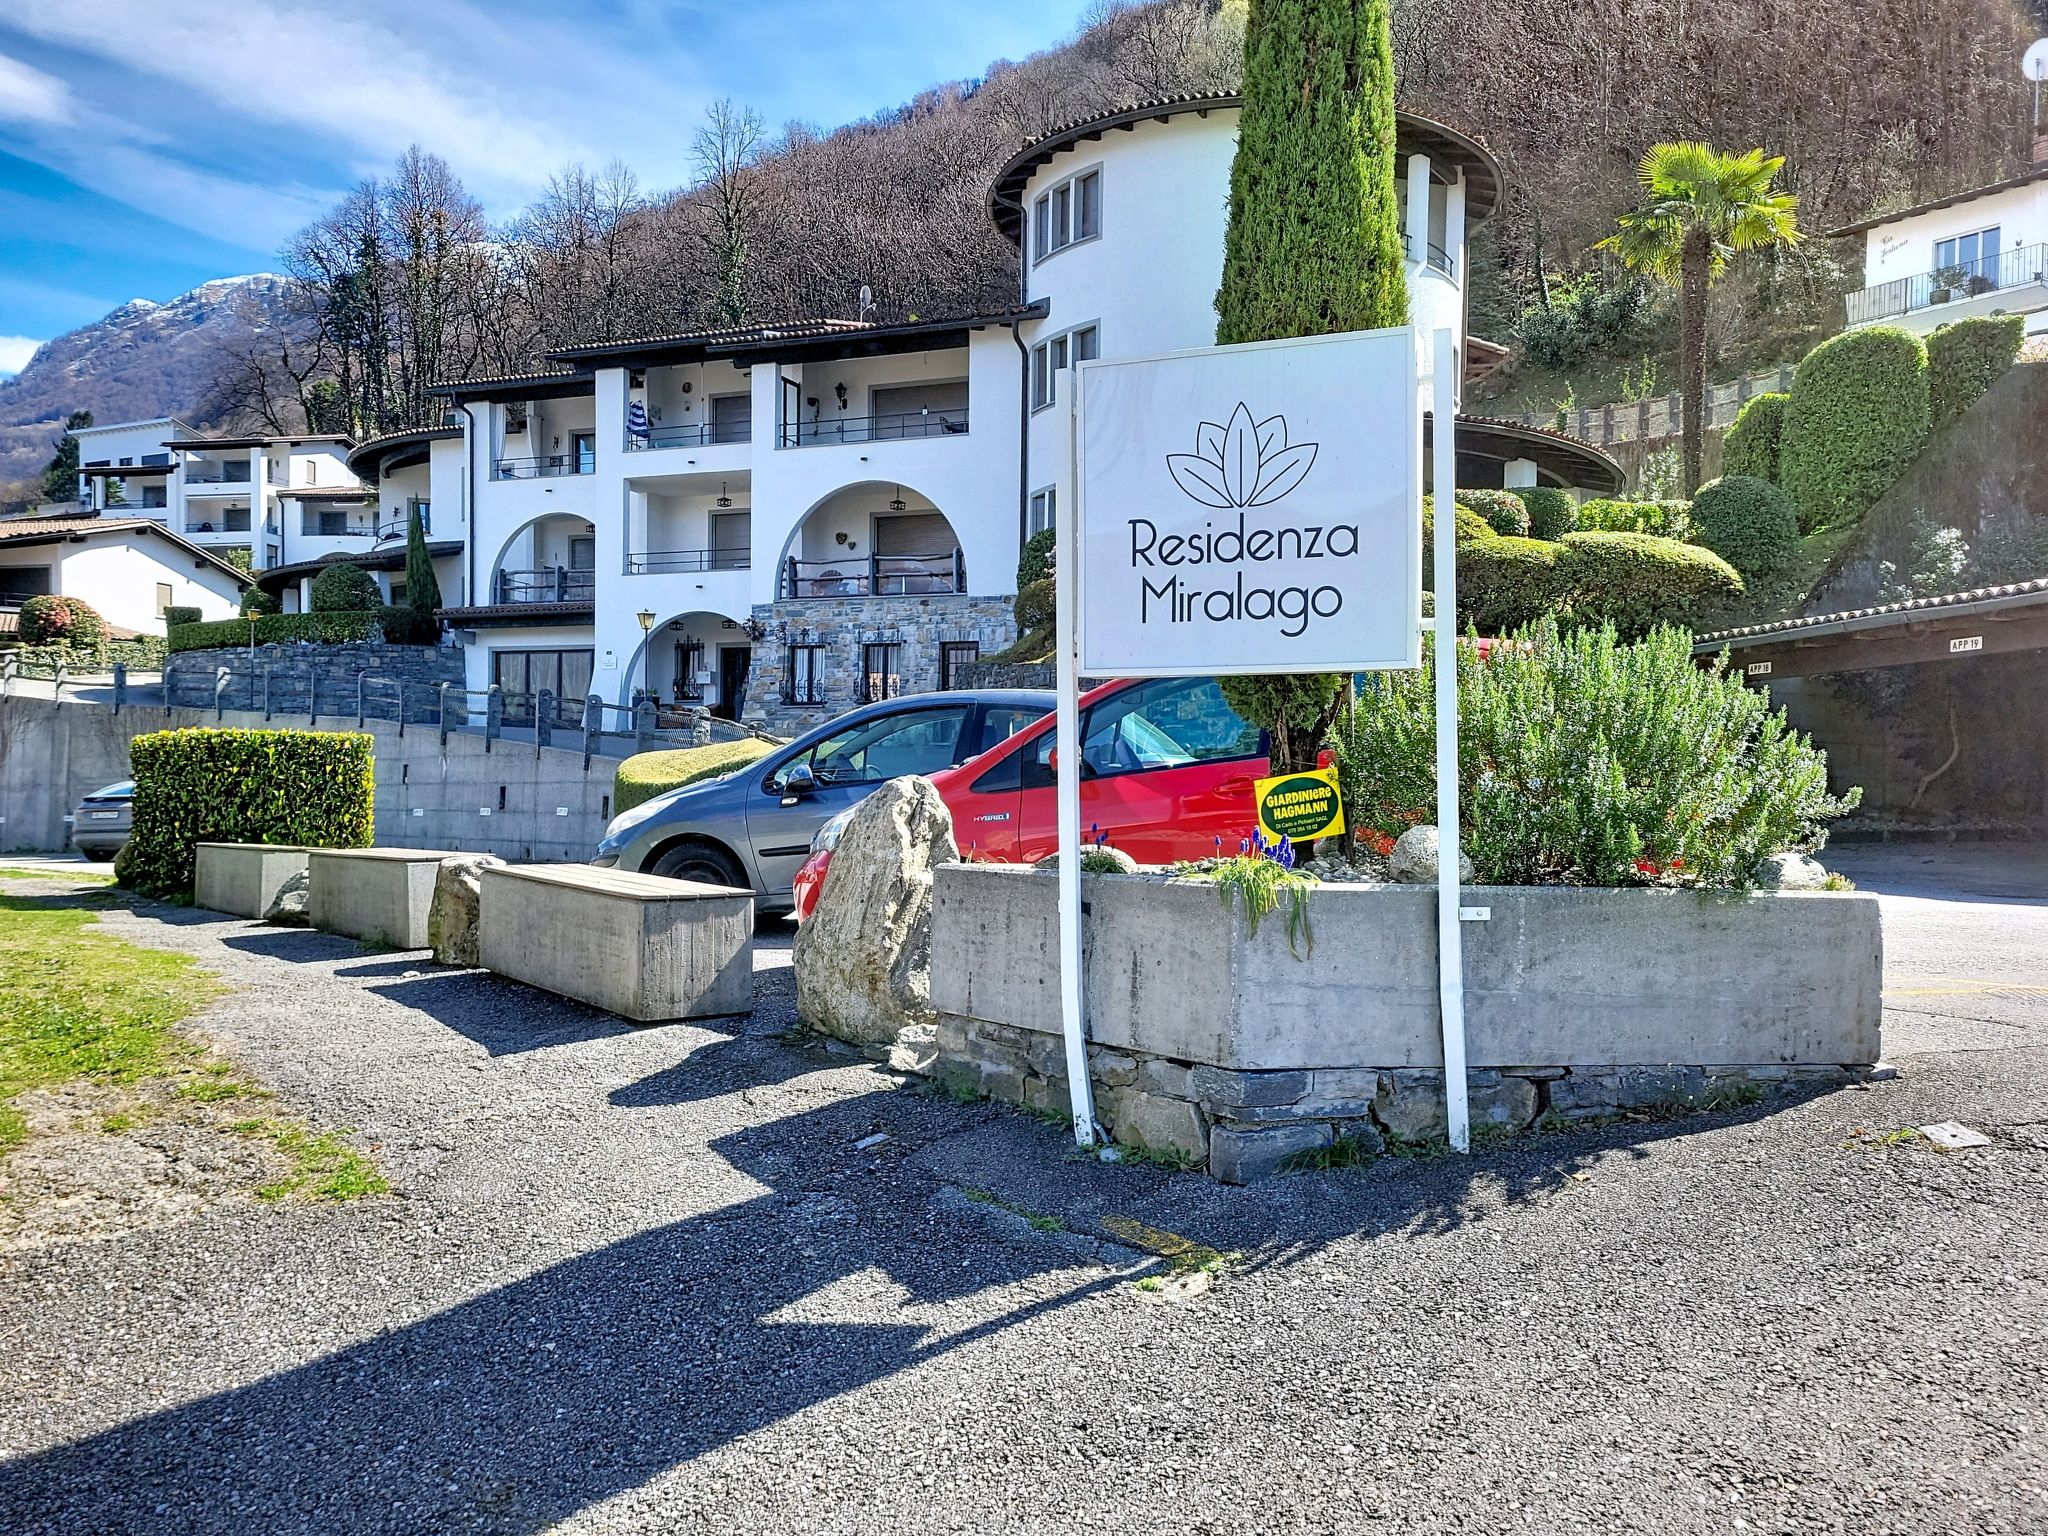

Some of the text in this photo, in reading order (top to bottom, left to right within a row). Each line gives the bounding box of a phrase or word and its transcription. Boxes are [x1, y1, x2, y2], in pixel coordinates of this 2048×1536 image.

[1127, 511, 1359, 567] Residenza
[1141, 570, 1343, 637] Miralago
[1951, 638, 1979, 650] APP 19
[1749, 664, 1762, 673] APP
[1273, 799, 1329, 820] HAGMANN
[973, 814, 1005, 822] HYBRID
